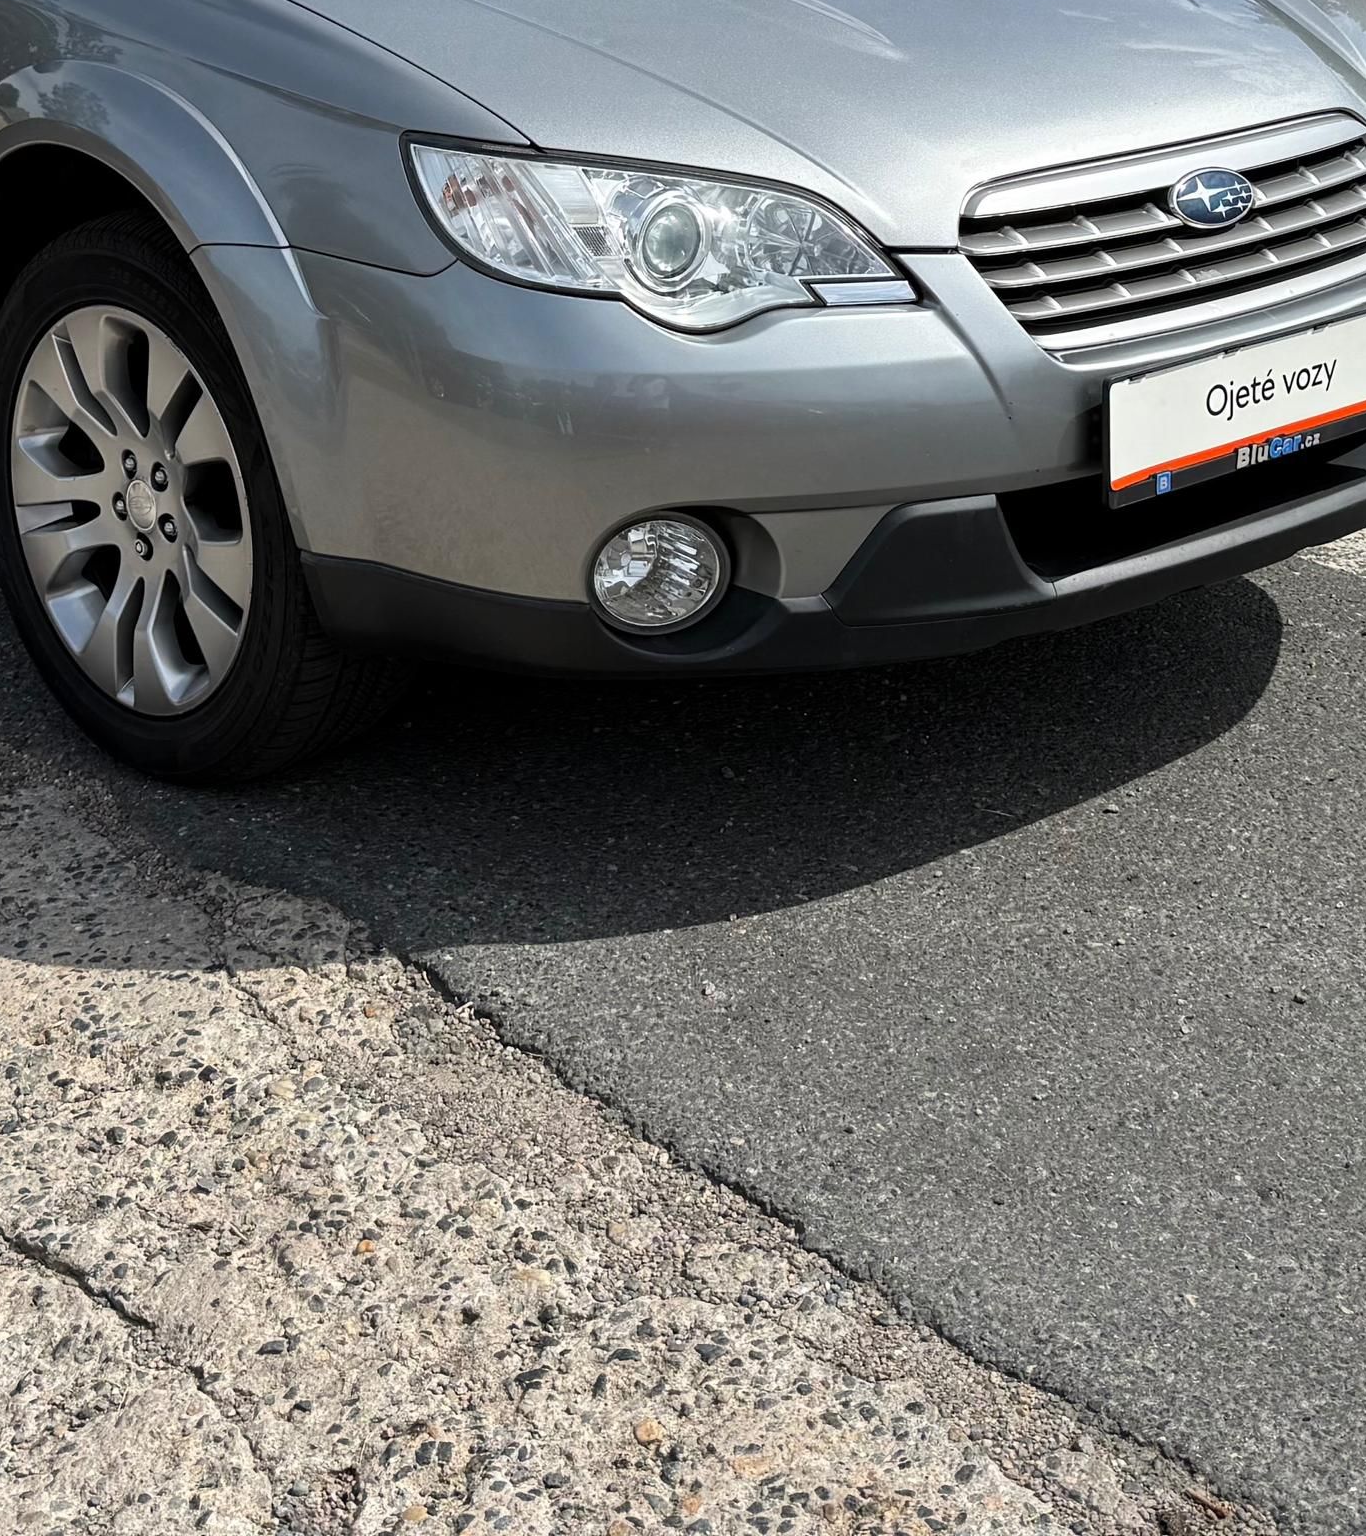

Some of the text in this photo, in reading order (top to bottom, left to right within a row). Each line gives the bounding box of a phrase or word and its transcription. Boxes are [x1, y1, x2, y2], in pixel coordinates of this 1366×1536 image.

[1206, 359, 1337, 421] Ojeté vozy
[1236, 433, 1321, 470] BluCar.cz
